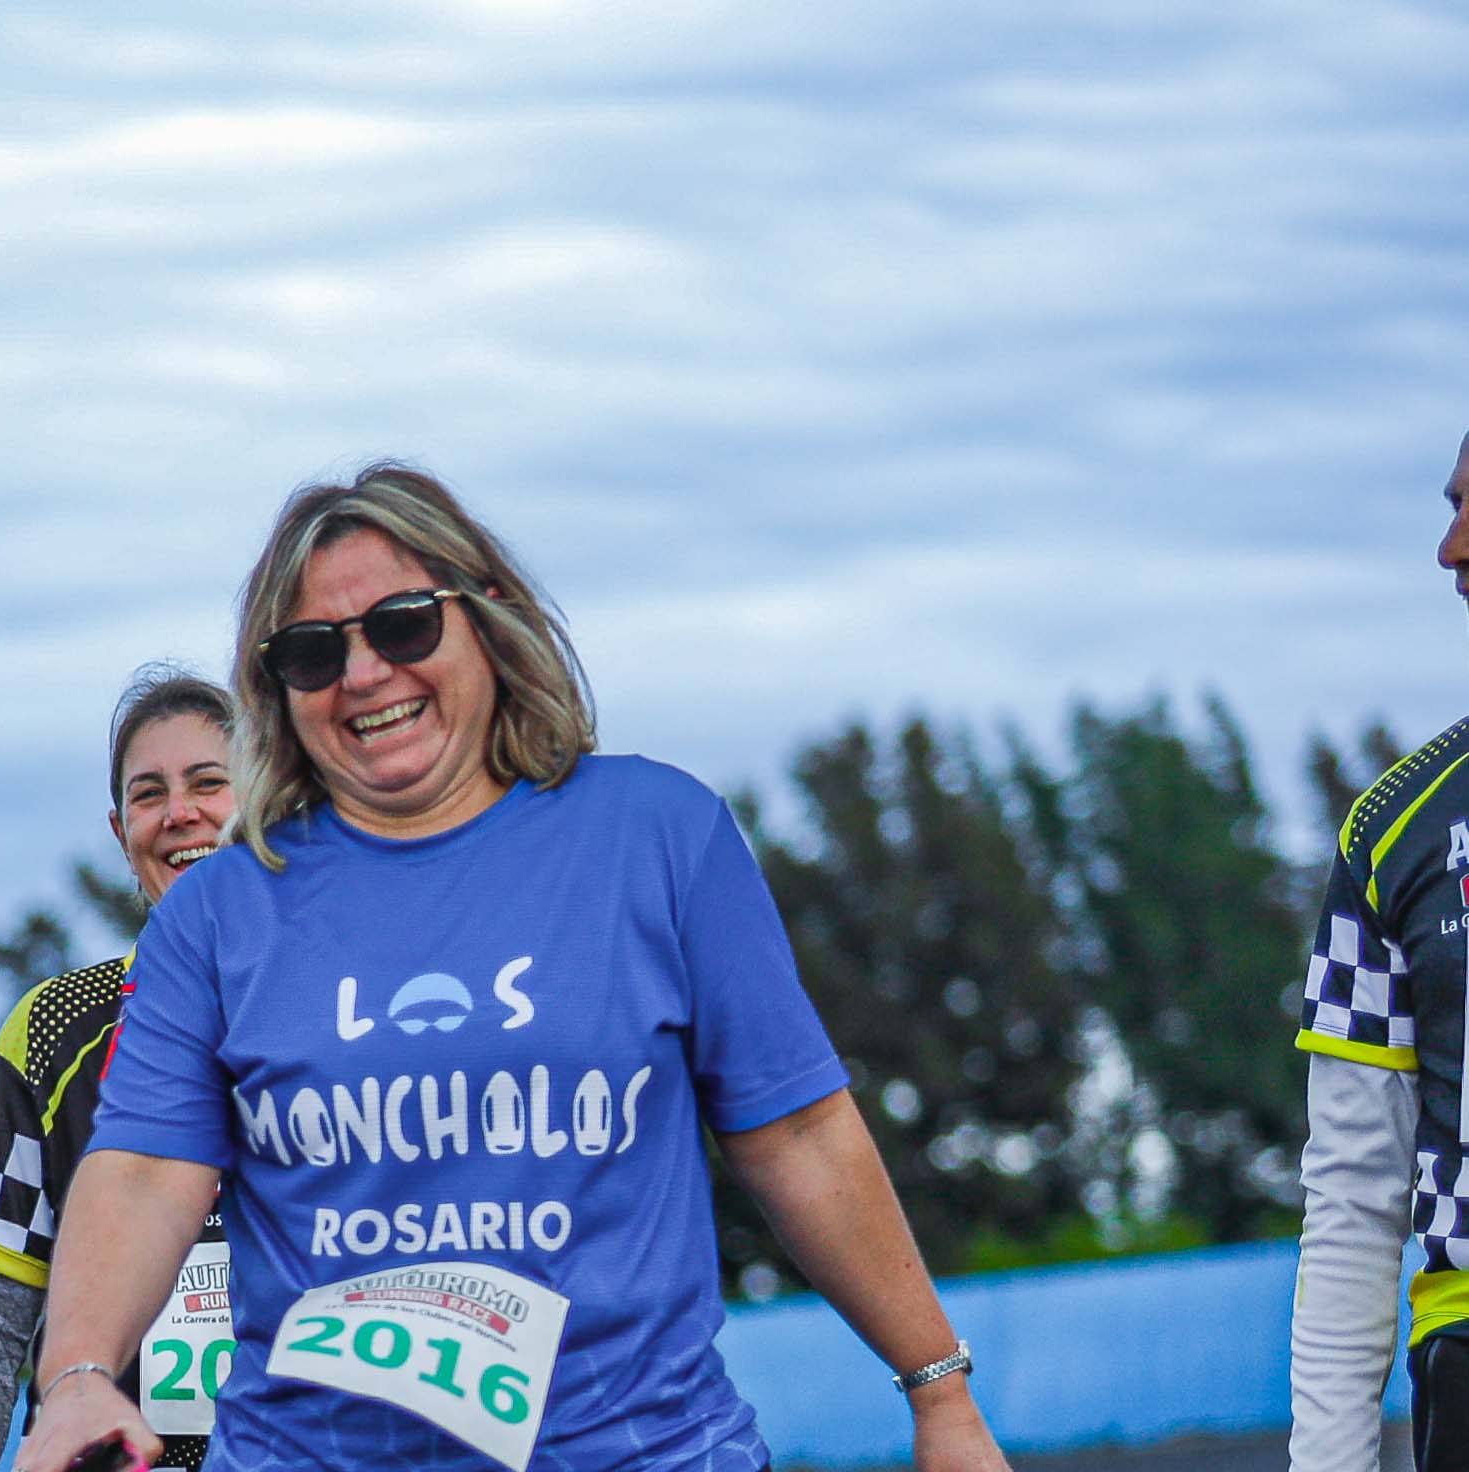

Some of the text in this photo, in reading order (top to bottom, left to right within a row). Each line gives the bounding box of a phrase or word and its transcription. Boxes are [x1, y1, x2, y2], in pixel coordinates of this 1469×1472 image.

[1441, 919, 1458, 935] La
[233, 1064, 652, 1167] MONCHOLOS
[311, 1201, 573, 1257] ROSARIO
[171, 1314, 230, 1325] La Carrera de
[150, 1338, 239, 1401] 20
[287, 1315, 531, 1425] 2016
